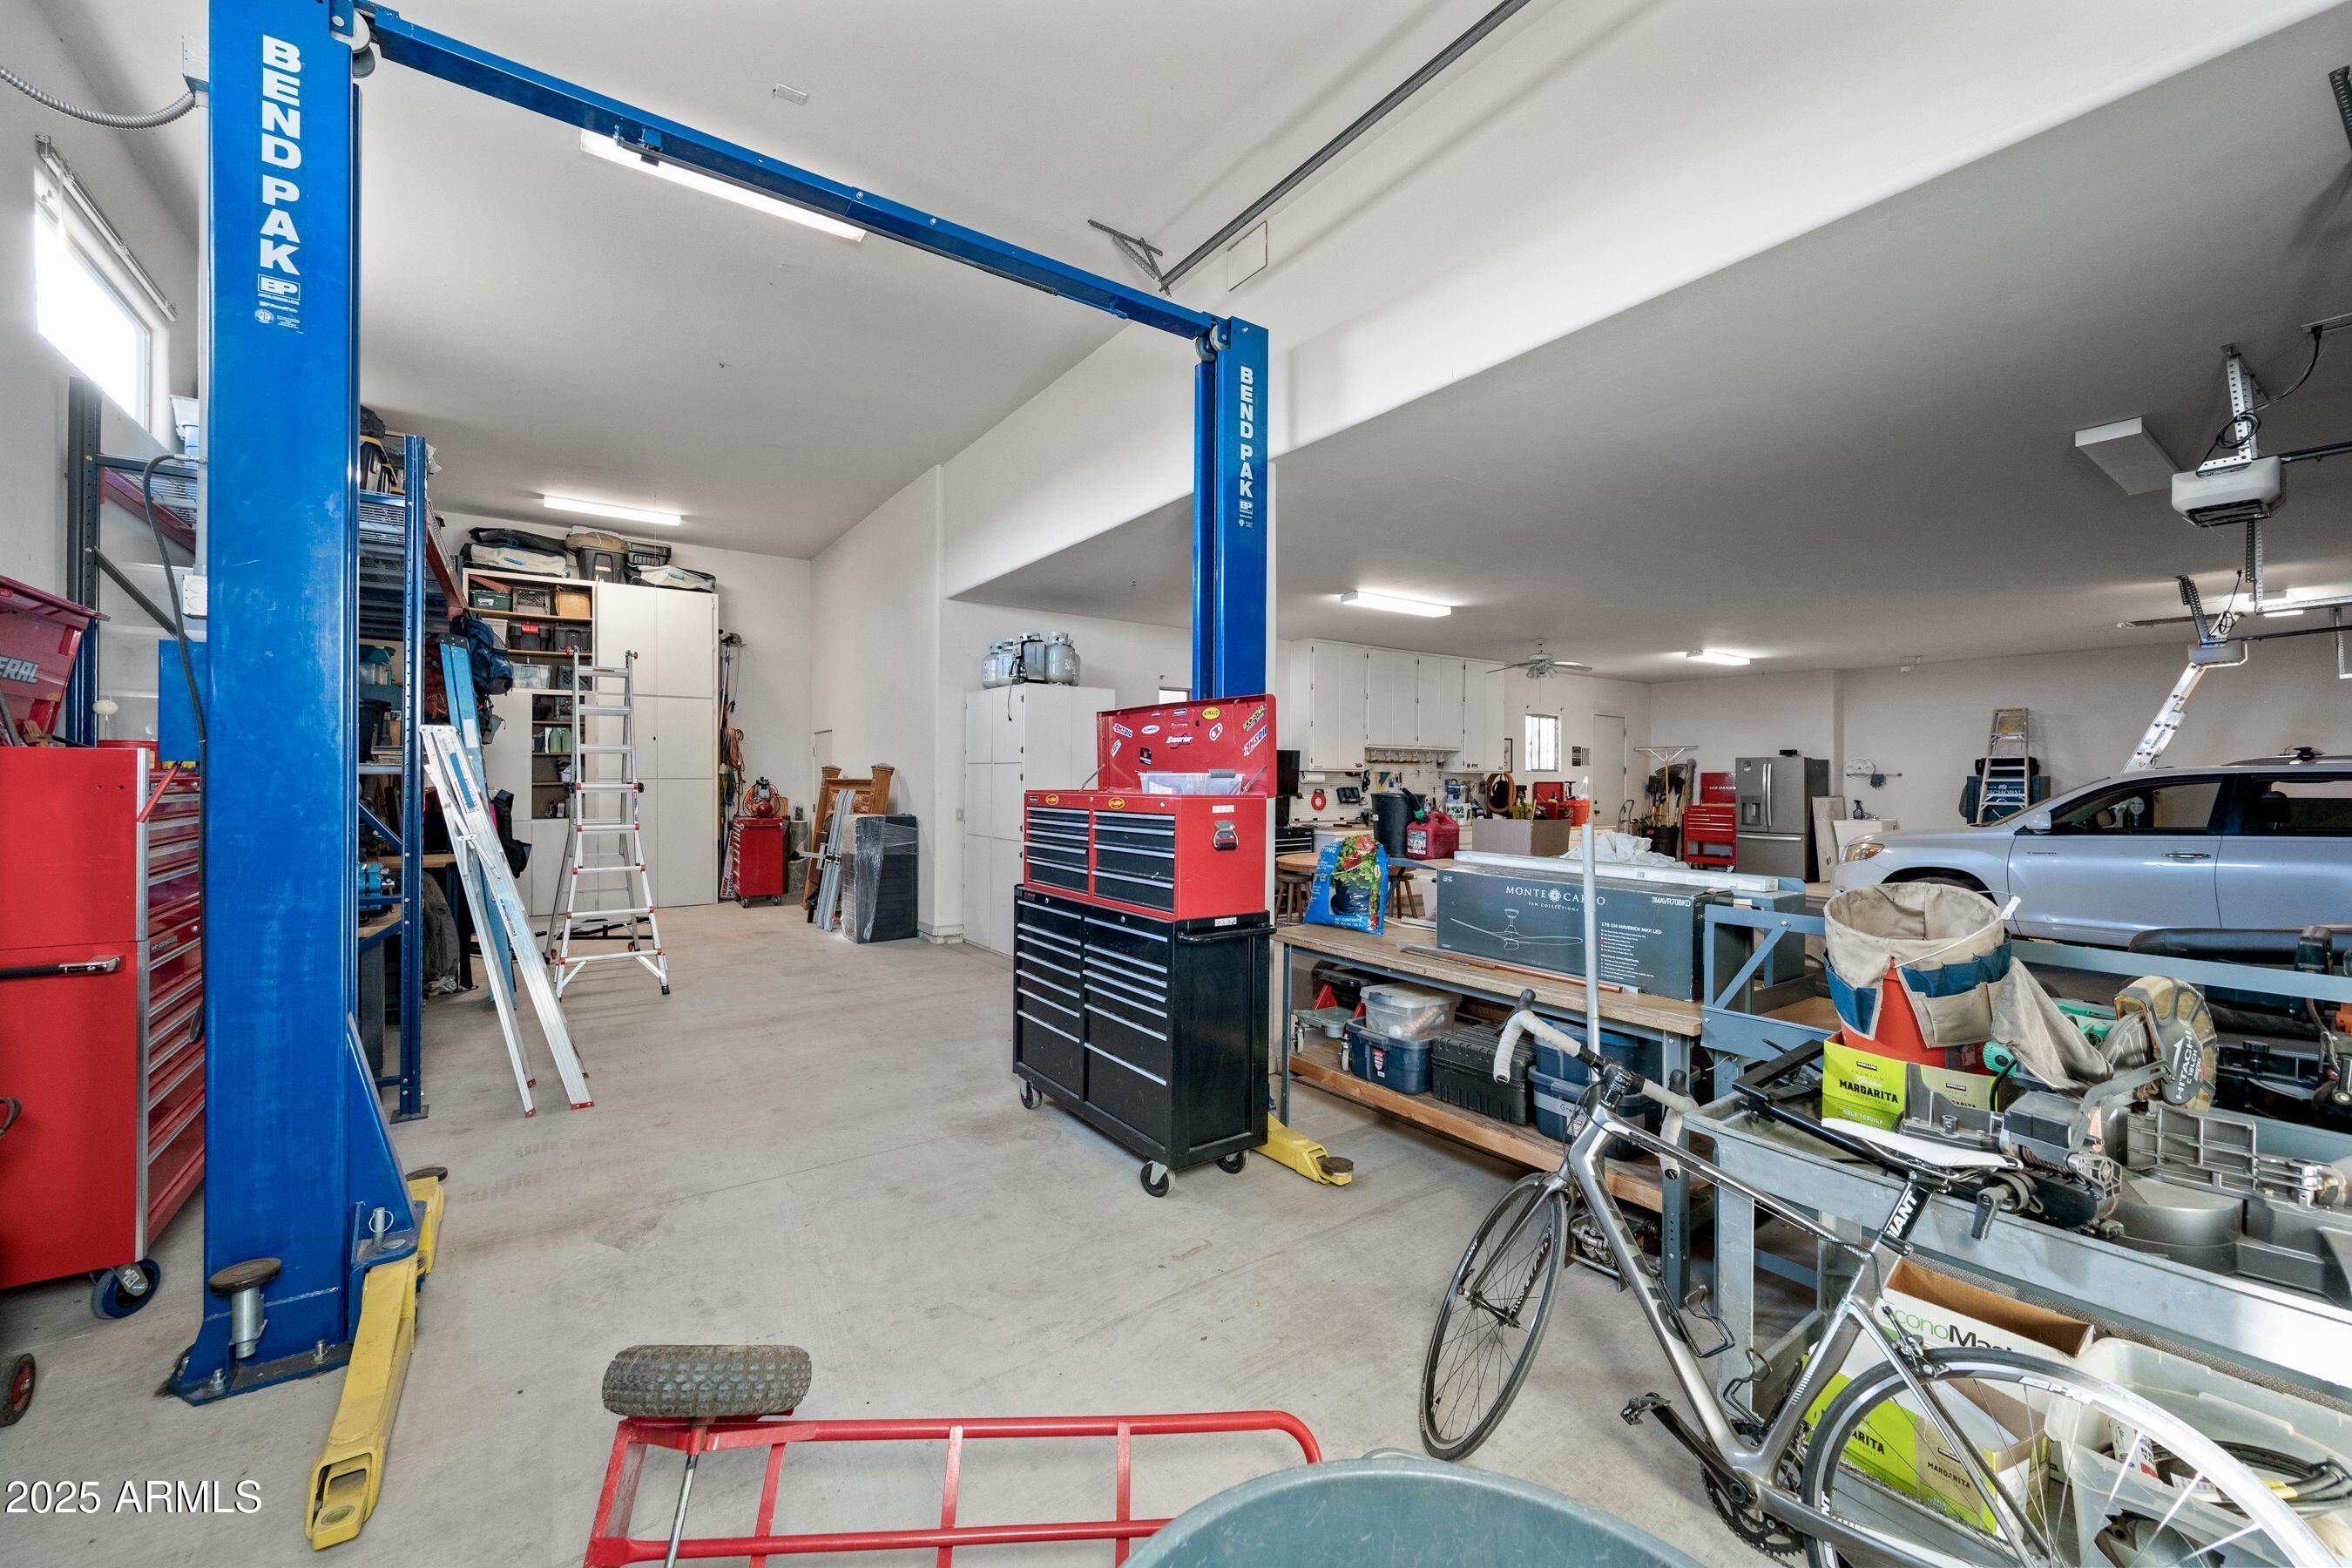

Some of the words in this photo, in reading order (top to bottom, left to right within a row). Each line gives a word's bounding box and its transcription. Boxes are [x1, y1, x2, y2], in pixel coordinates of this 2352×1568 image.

[261, 34, 301, 169] BEND
[260, 174, 301, 276] PAK
[260, 276, 298, 295] BP
[1240, 365, 1254, 439] BEND
[1240, 444, 1253, 498] PAK
[1114, 723, 1132, 738] AMSOIL
[1505, 886, 1546, 898] MONTE
[1563, 892, 1605, 905] CAO
[1651, 896, 1691, 907] 3MAVR70BKD
[2176, 1030, 2193, 1100] HITACHI
[1839, 1079, 1898, 1104] MARGARITA
[1859, 1114, 1883, 1125] TEQUILA
[1886, 1301, 2012, 1351] conoM
[1852, 1429, 1885, 1455] ARITA
[1927, 1461, 1971, 1489] MARGARITA
